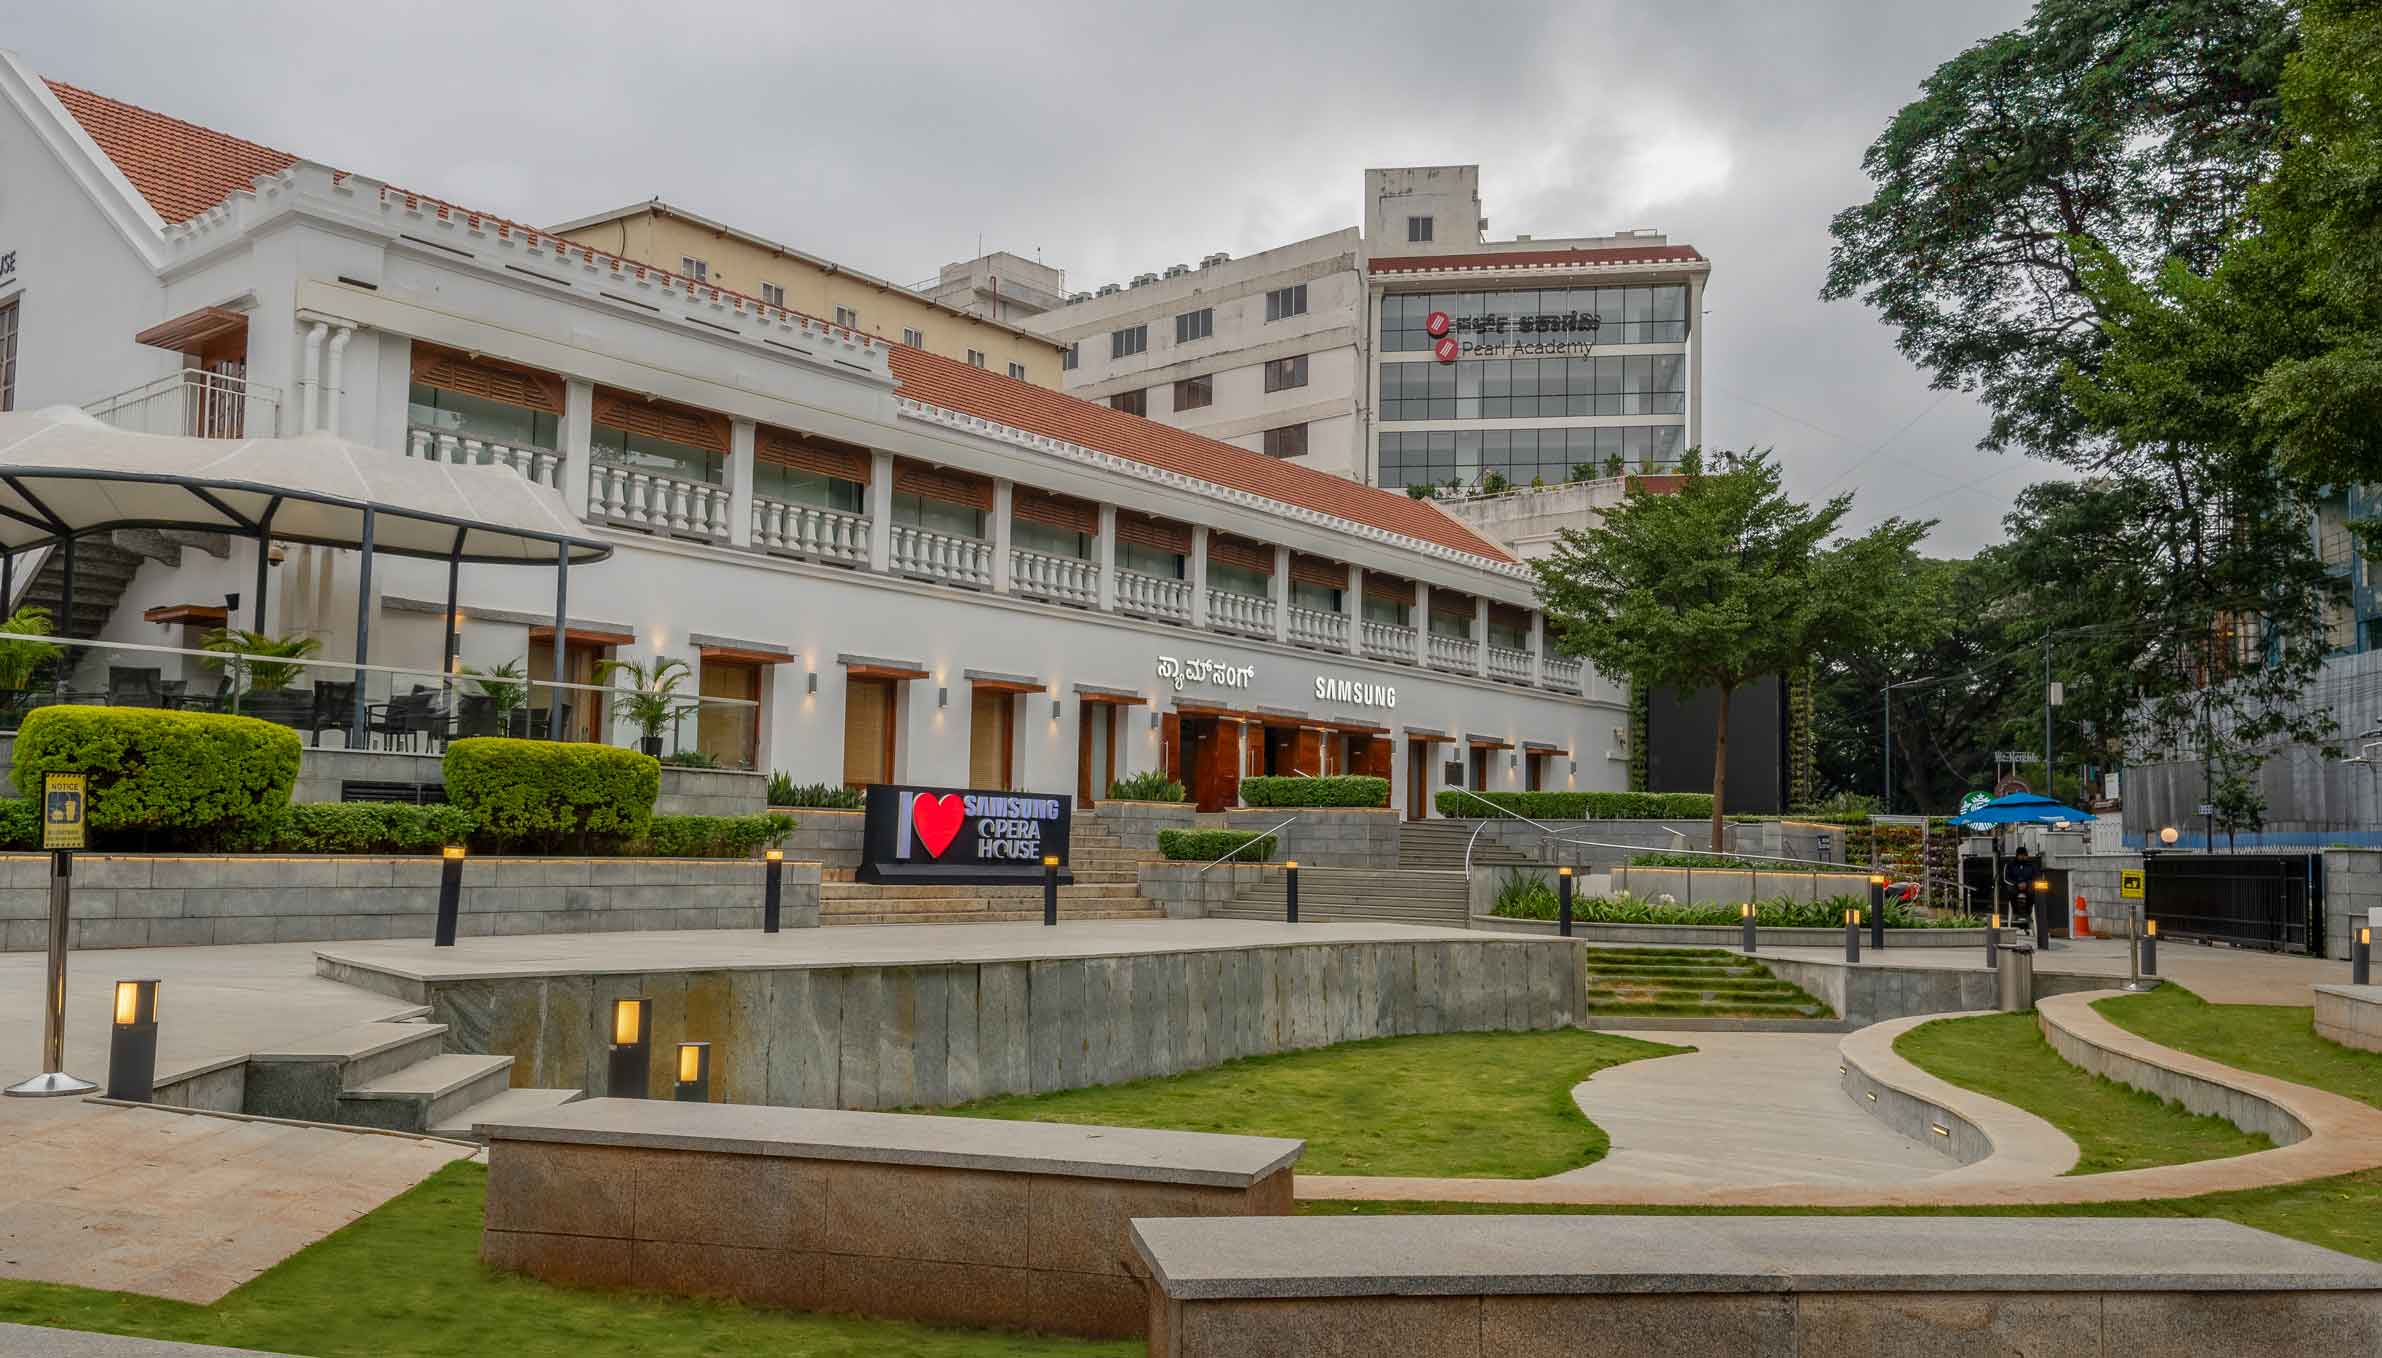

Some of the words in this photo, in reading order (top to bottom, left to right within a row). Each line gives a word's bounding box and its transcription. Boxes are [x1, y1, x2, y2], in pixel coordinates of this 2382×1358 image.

[1462, 340, 1505, 356] Pearl
[1513, 338, 1594, 362] Academy
[1315, 676, 1396, 708] SAMSUNG
[51, 783, 79, 791] NOTICE
[963, 795, 1059, 820] SAMSUNG
[895, 791, 914, 860] I
[977, 819, 1041, 839] OPERA
[977, 838, 1040, 860] HOUSE
